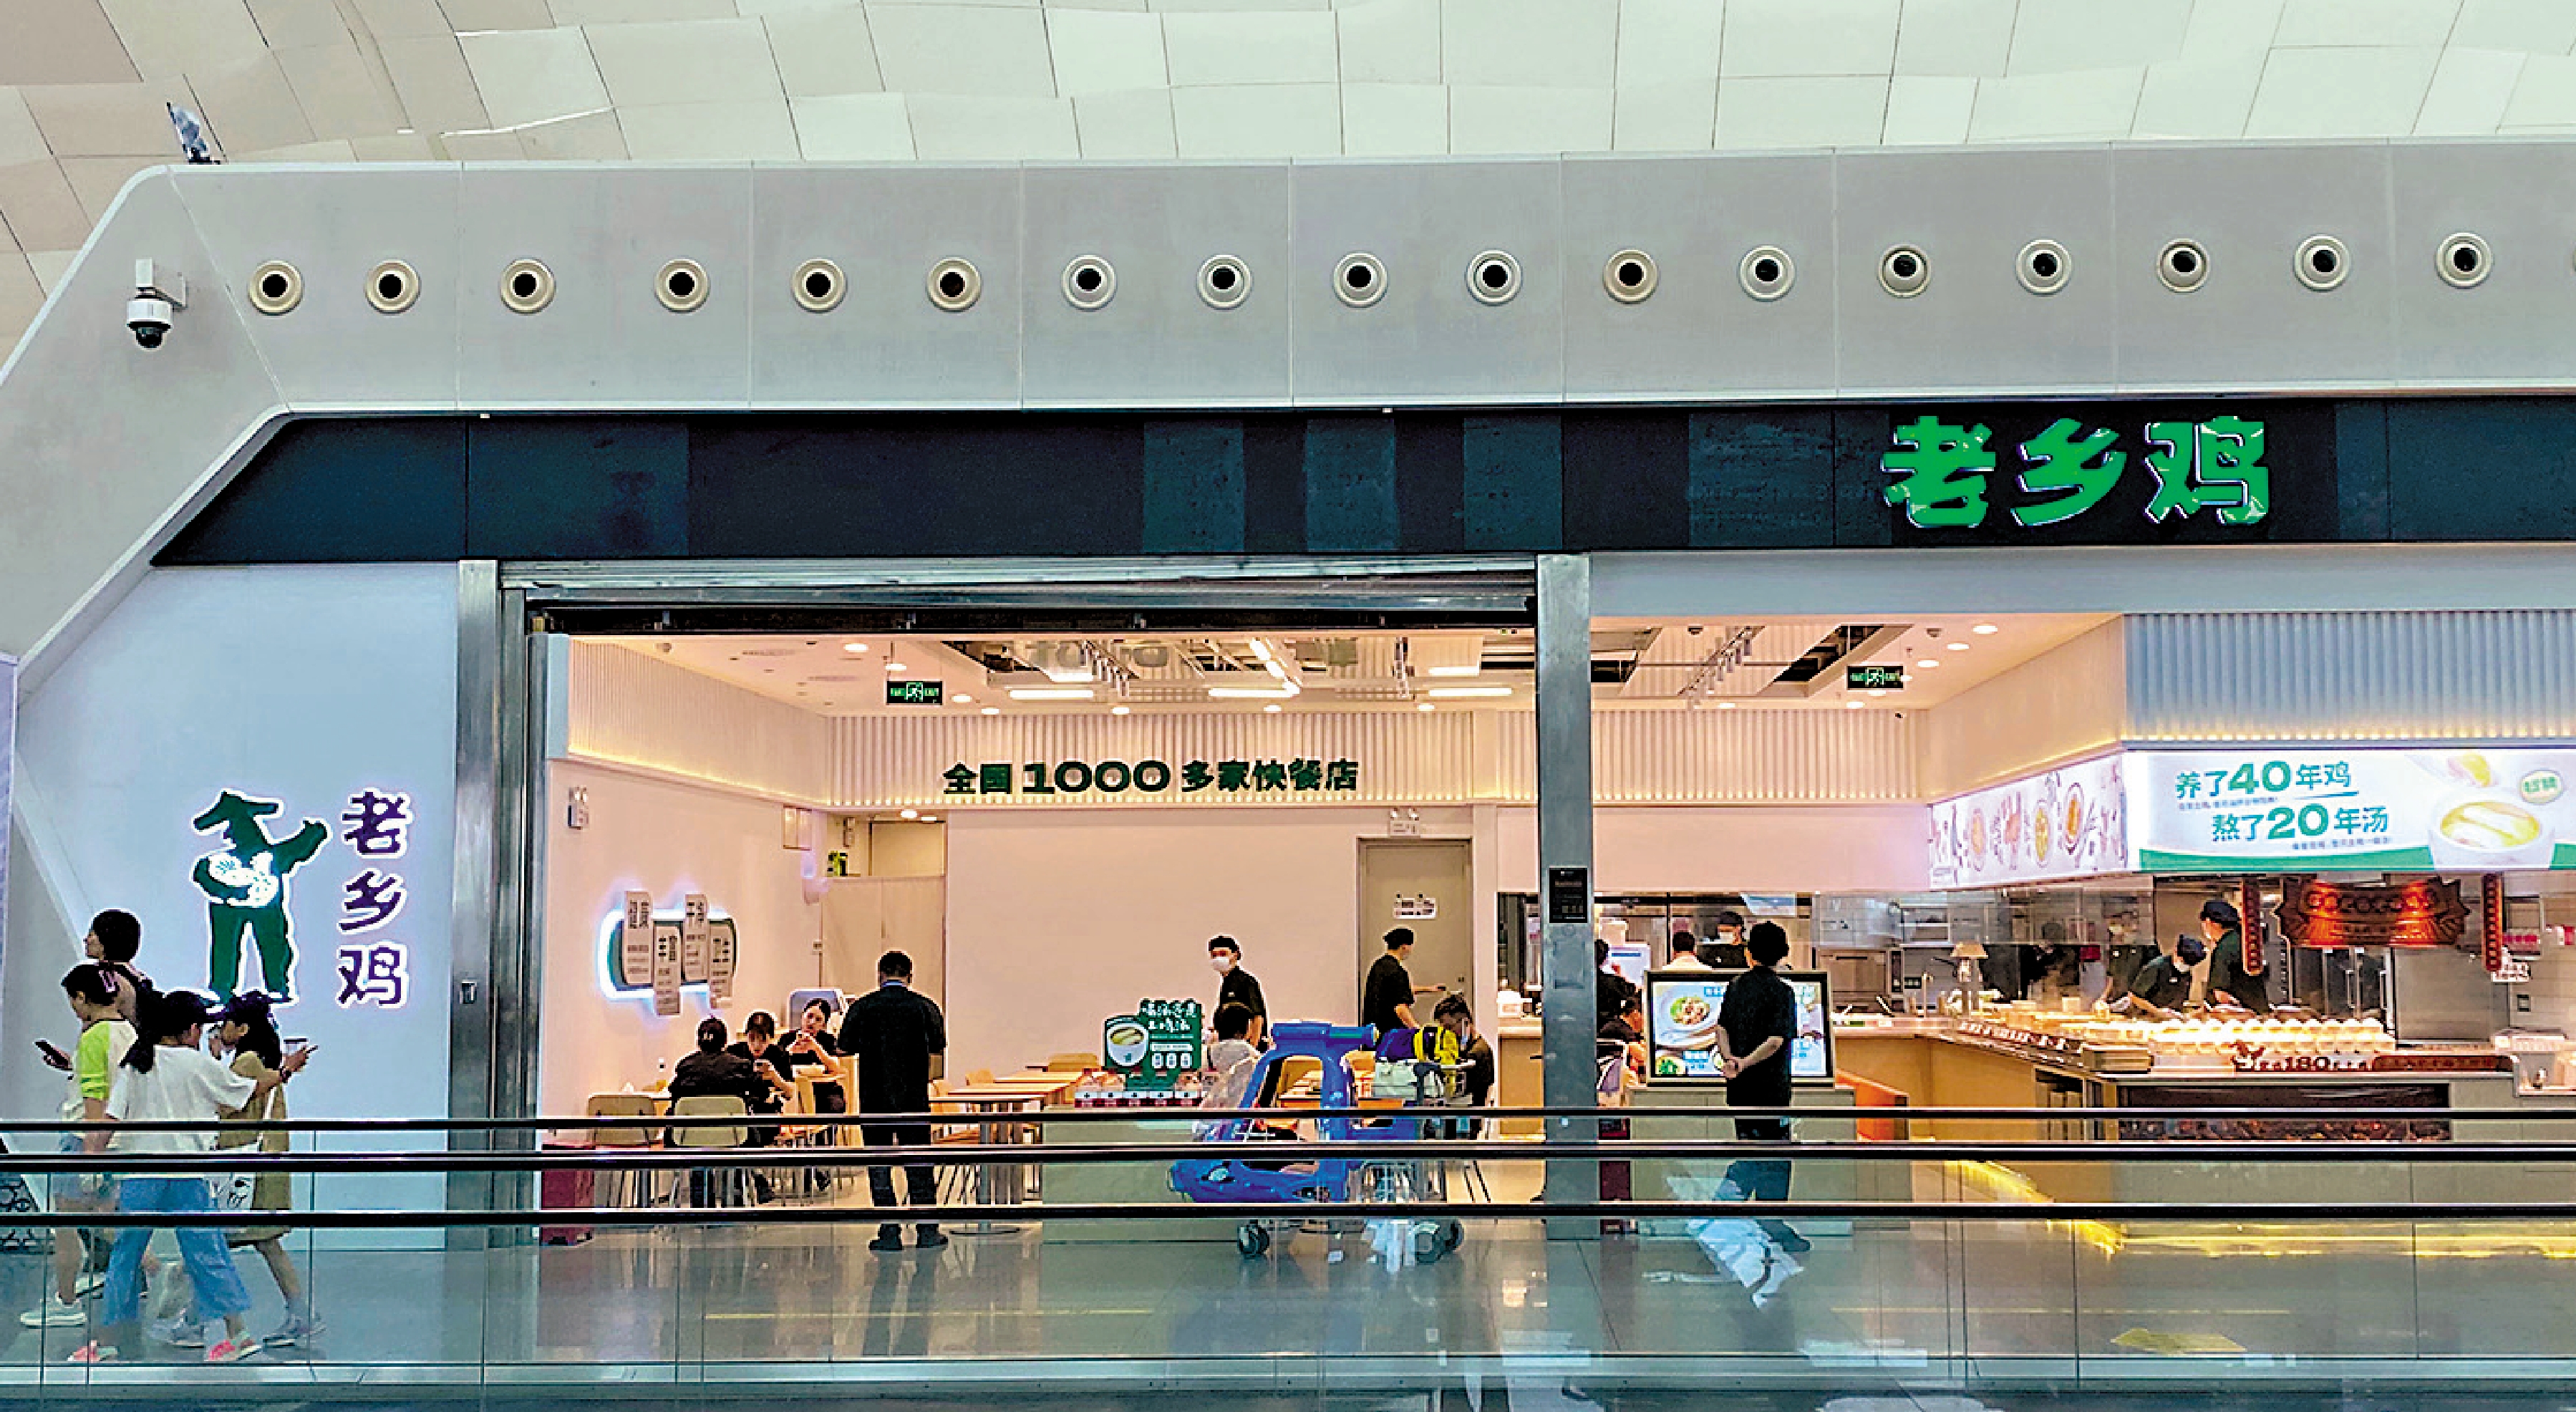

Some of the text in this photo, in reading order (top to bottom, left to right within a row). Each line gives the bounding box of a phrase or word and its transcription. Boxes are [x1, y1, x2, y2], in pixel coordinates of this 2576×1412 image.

[1880, 415, 2269, 528] 老乡鸡
[942, 760, 1359, 794] 全国1000多家快餐店
[2174, 760, 2352, 800] 养了40年鸡
[2211, 803, 2389, 842] 熬了20年汤
[338, 790, 407, 1005] 老乡鸡
